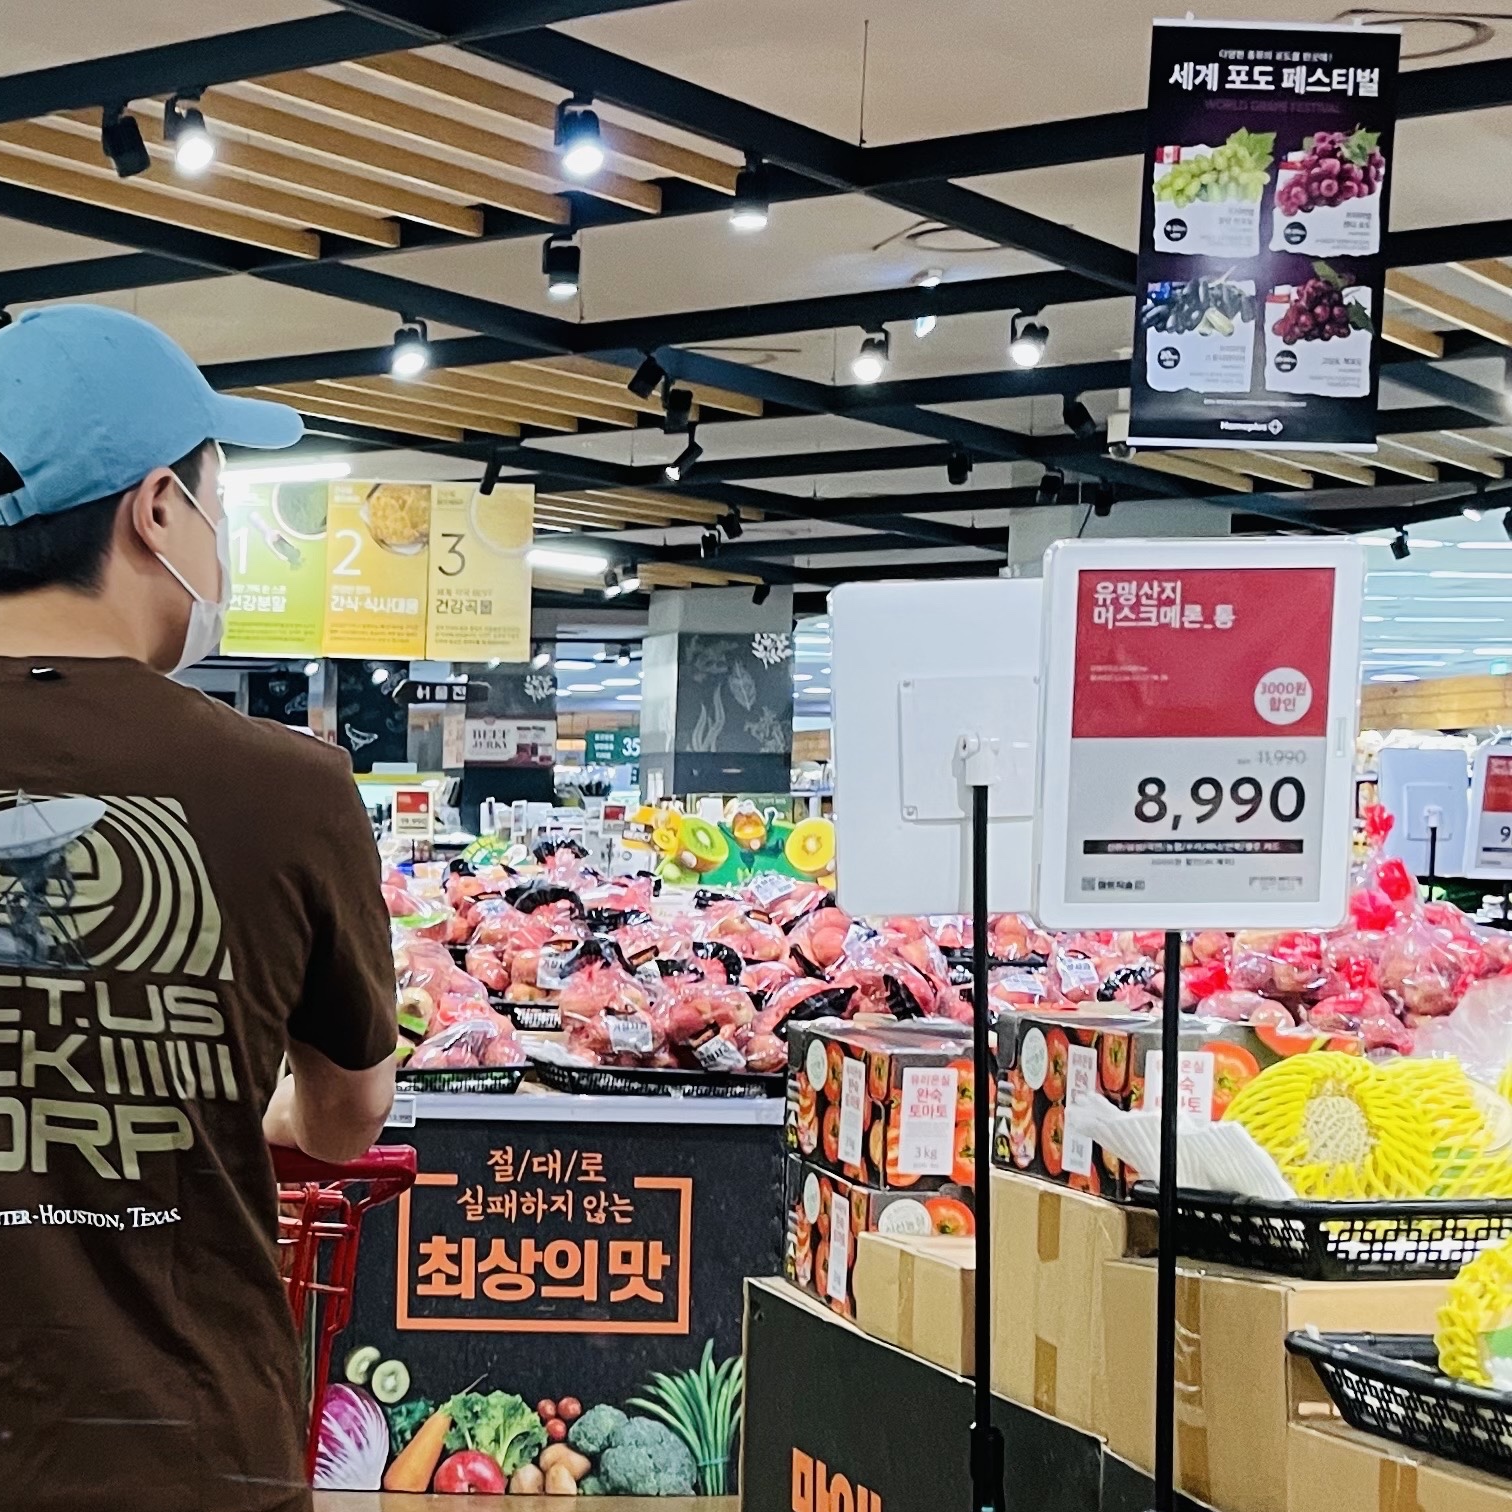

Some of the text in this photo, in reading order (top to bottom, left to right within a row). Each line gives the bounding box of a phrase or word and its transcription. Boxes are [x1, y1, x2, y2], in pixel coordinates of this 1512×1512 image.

[1168, 61, 1379, 97] 세계 포도 페스티벌
[333, 528, 363, 577] 2
[438, 532, 466, 577] 3
[1093, 579, 1182, 606] 유명산지
[1134, 776, 1306, 831] 8,990
[908, 1103, 948, 1119] 토마토
[916, 1087, 943, 1103] 완숙
[486, 1145, 607, 1184] 절/대/로
[456, 1184, 635, 1225] 실패하지 않는
[416, 1235, 671, 1304] 최상의 맛
